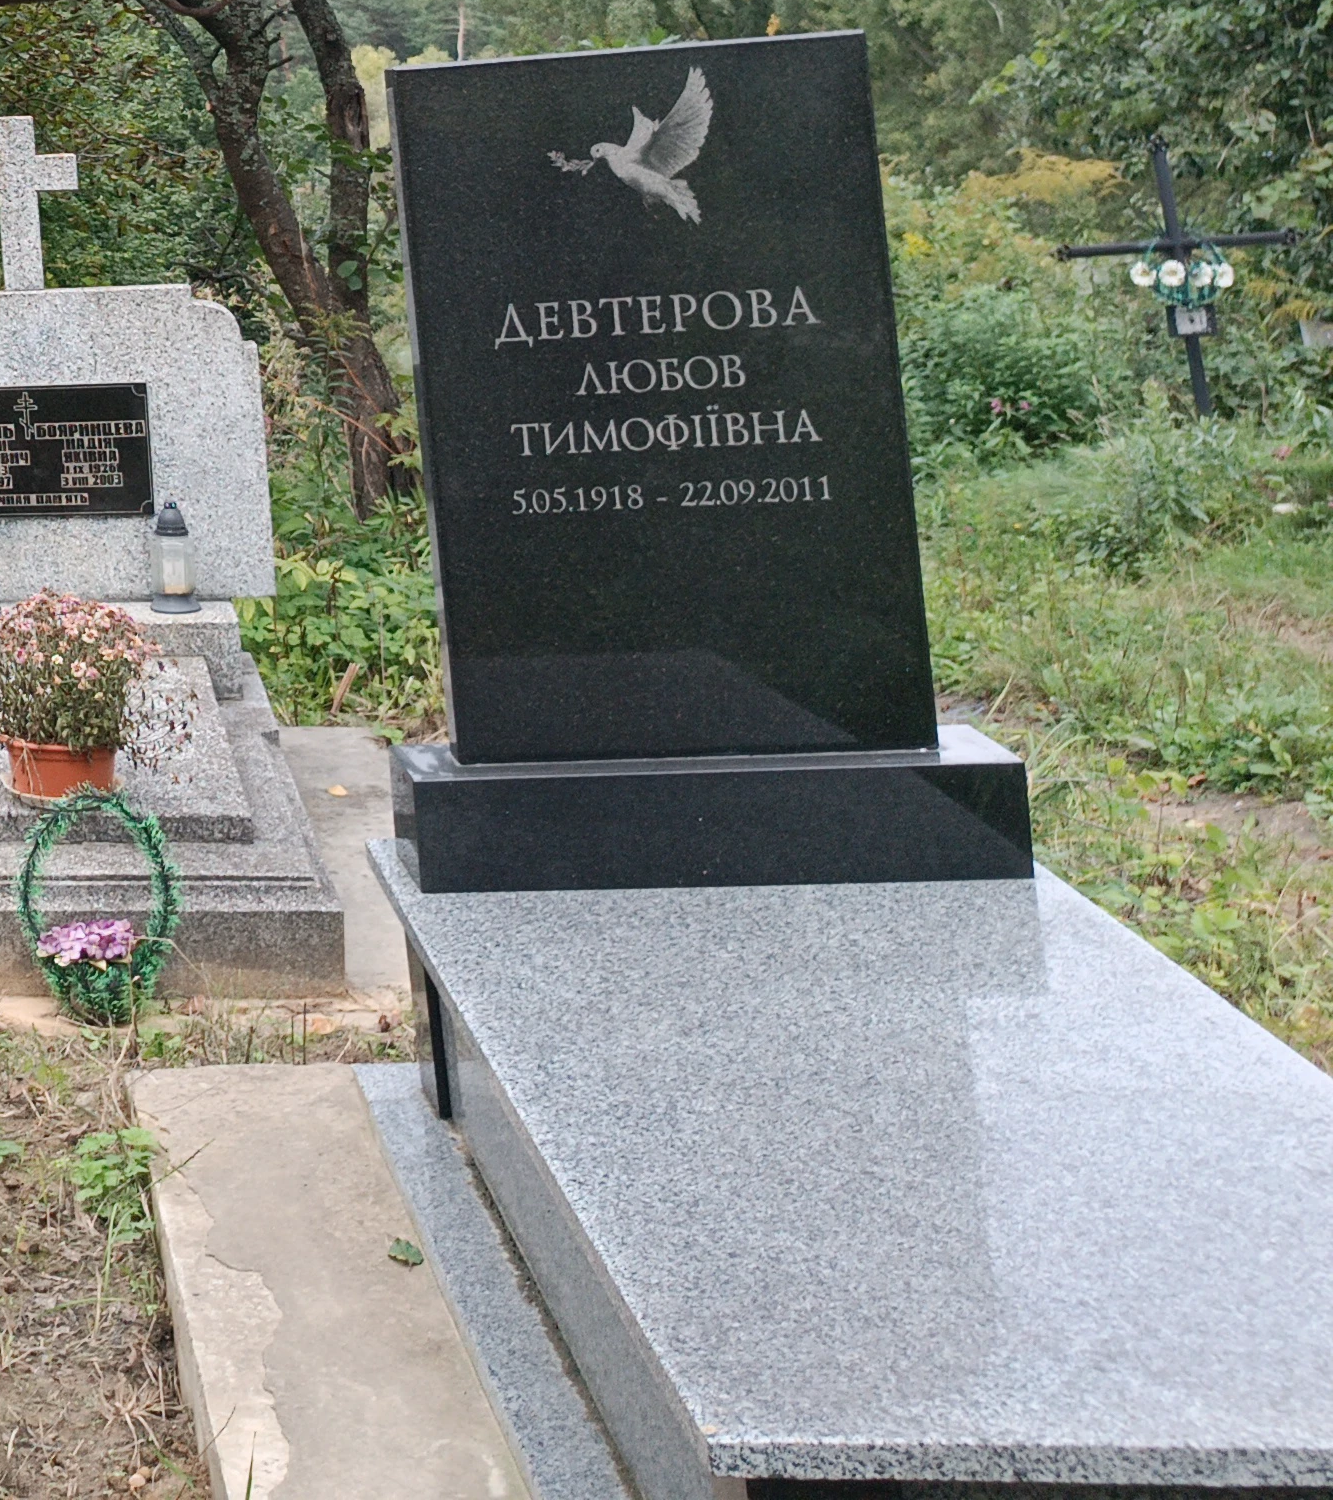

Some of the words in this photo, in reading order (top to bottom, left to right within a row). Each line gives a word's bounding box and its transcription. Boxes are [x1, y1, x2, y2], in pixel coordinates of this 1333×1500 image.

[494, 285, 822, 350] ДЕВТЕРОВА
[574, 354, 747, 396] ЛЮБОВ
[510, 404, 823, 456] ТИМОФІЇВНА
[512, 484, 645, 514] 5.05.1918
[679, 475, 833, 506] 22.09.2011
